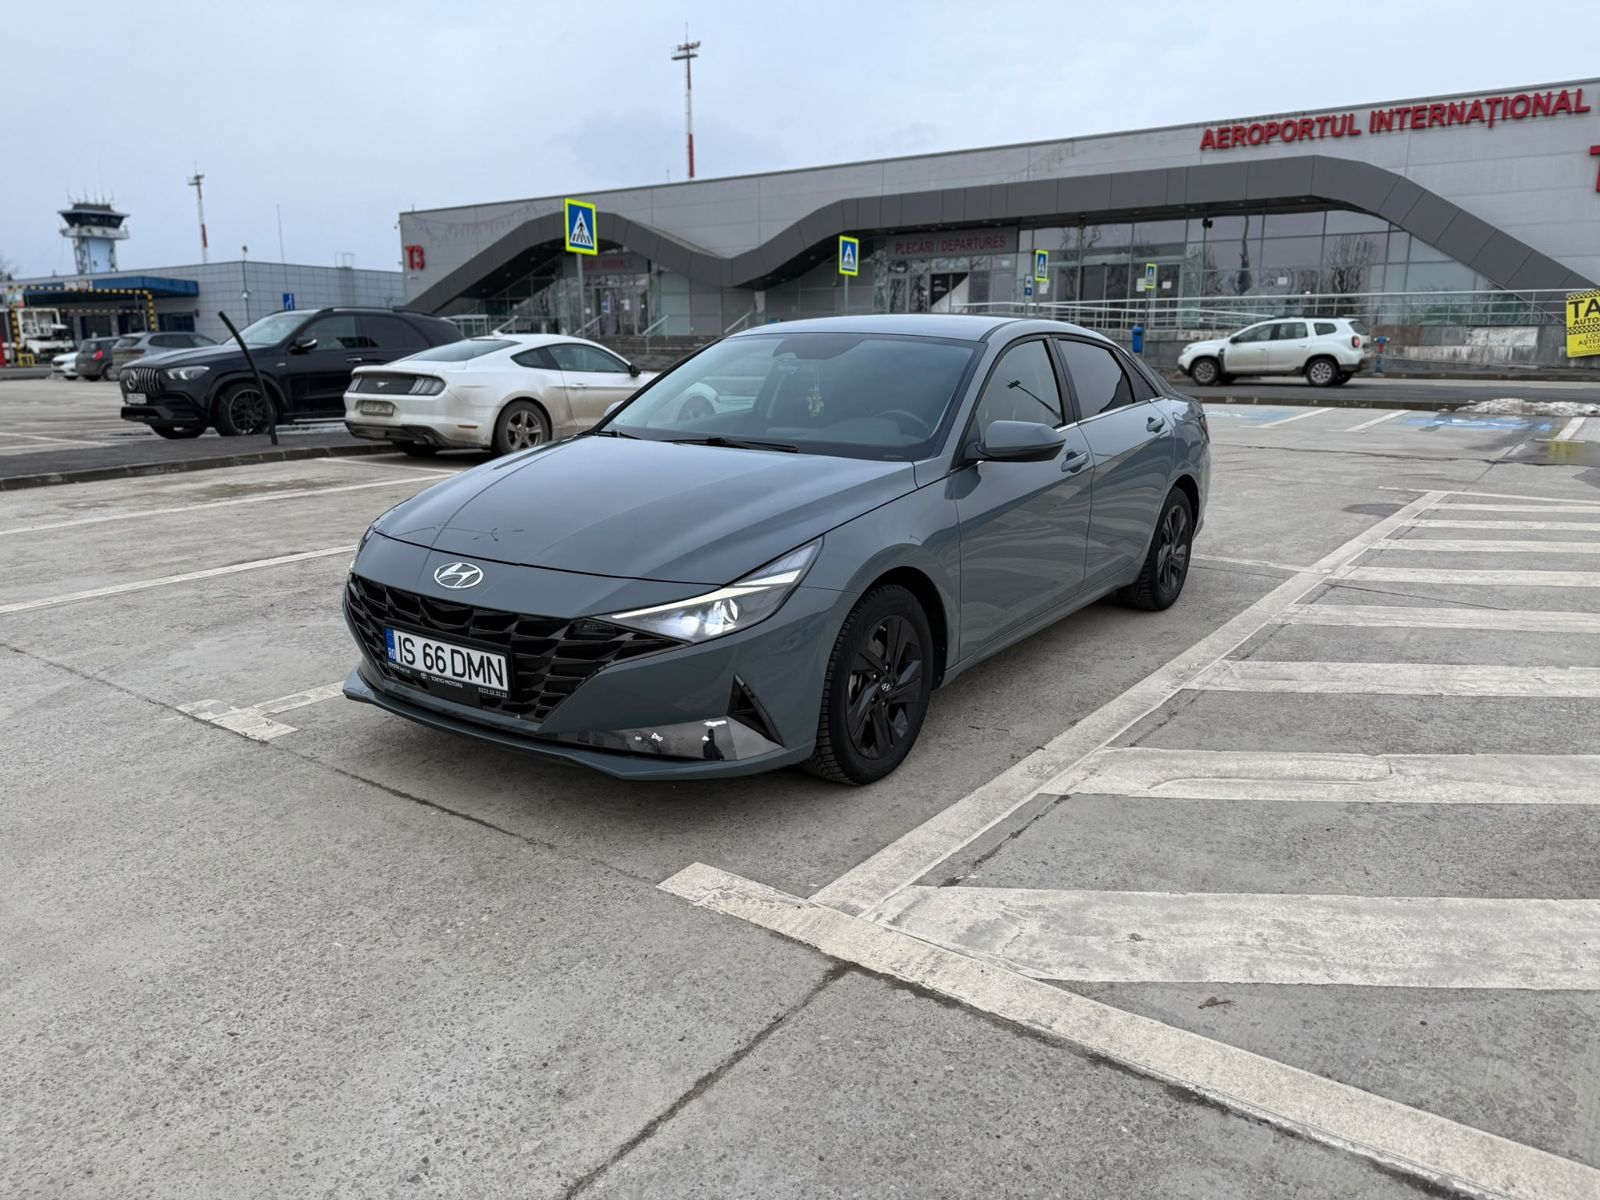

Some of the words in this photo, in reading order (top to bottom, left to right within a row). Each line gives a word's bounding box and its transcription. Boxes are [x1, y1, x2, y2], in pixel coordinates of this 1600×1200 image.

[1200, 113, 1361, 150] AEROPORTUL
[941, 235, 1006, 252] DEPARTURES
[404, 245, 425, 270] T3
[1573, 316, 1600, 326] AUTO
[398, 635, 416, 665] IS
[422, 643, 446, 674] 66
[450, 648, 504, 687] DMN
[444, 679, 463, 689] MOTORS
